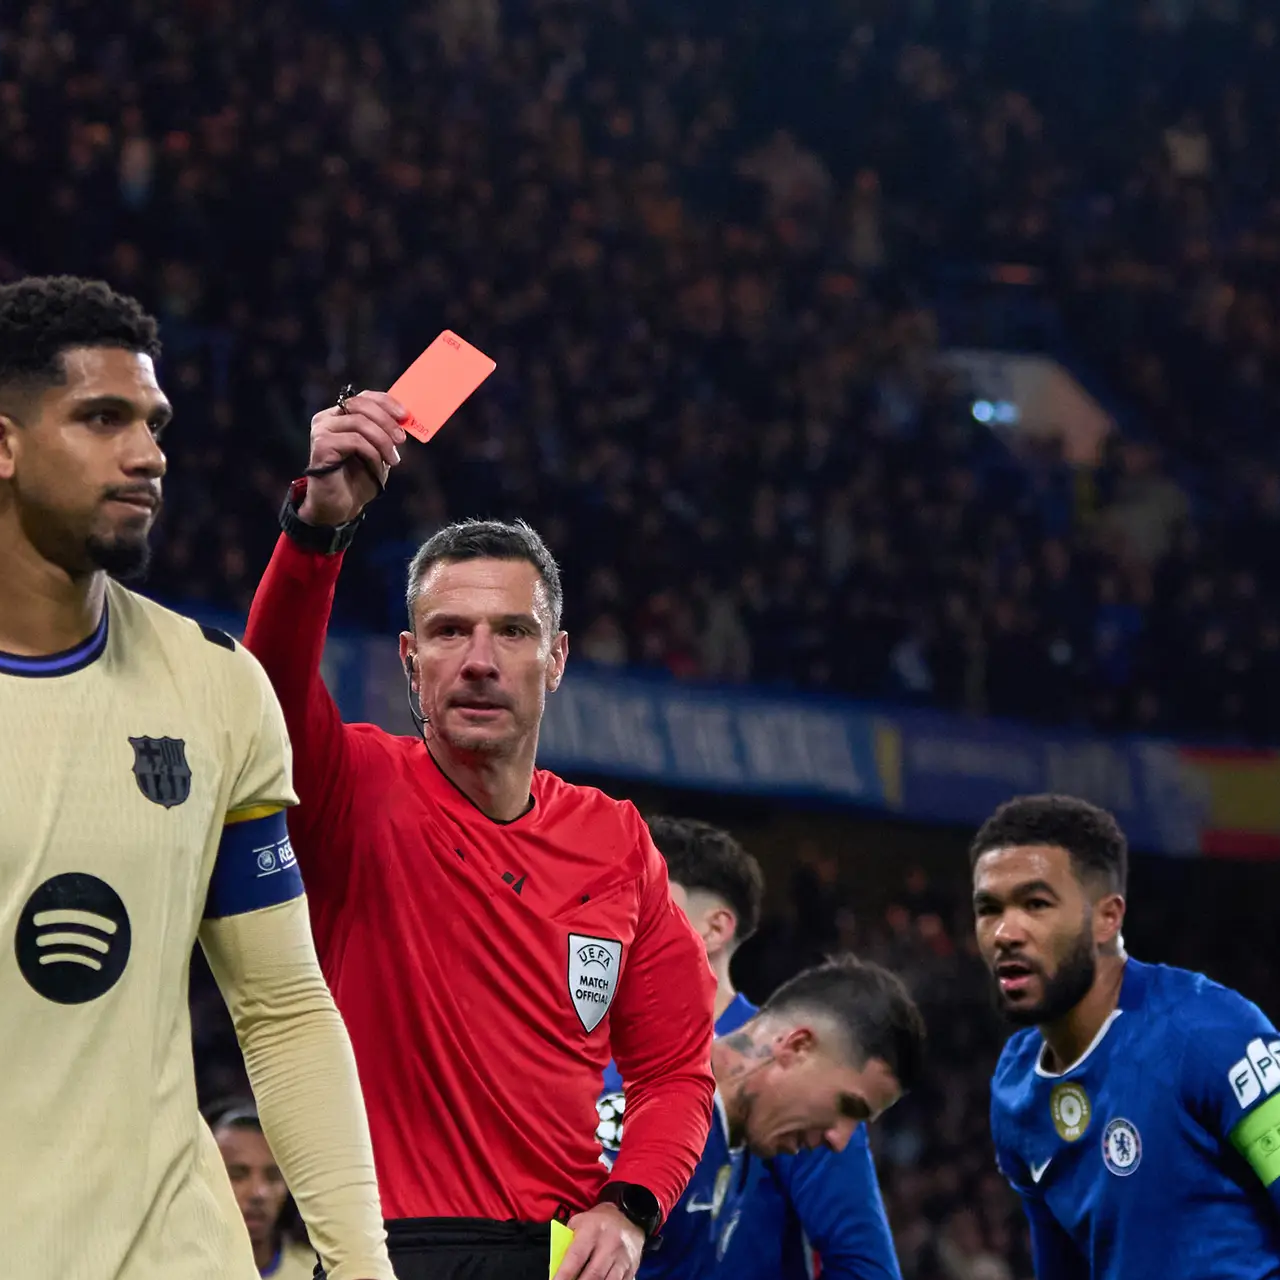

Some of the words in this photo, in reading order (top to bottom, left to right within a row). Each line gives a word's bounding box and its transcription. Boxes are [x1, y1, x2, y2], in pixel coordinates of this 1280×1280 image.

[579, 948, 610, 967] UEFA
[580, 975, 609, 990] MATCH
[576, 989, 608, 1004] OFFICIAL
